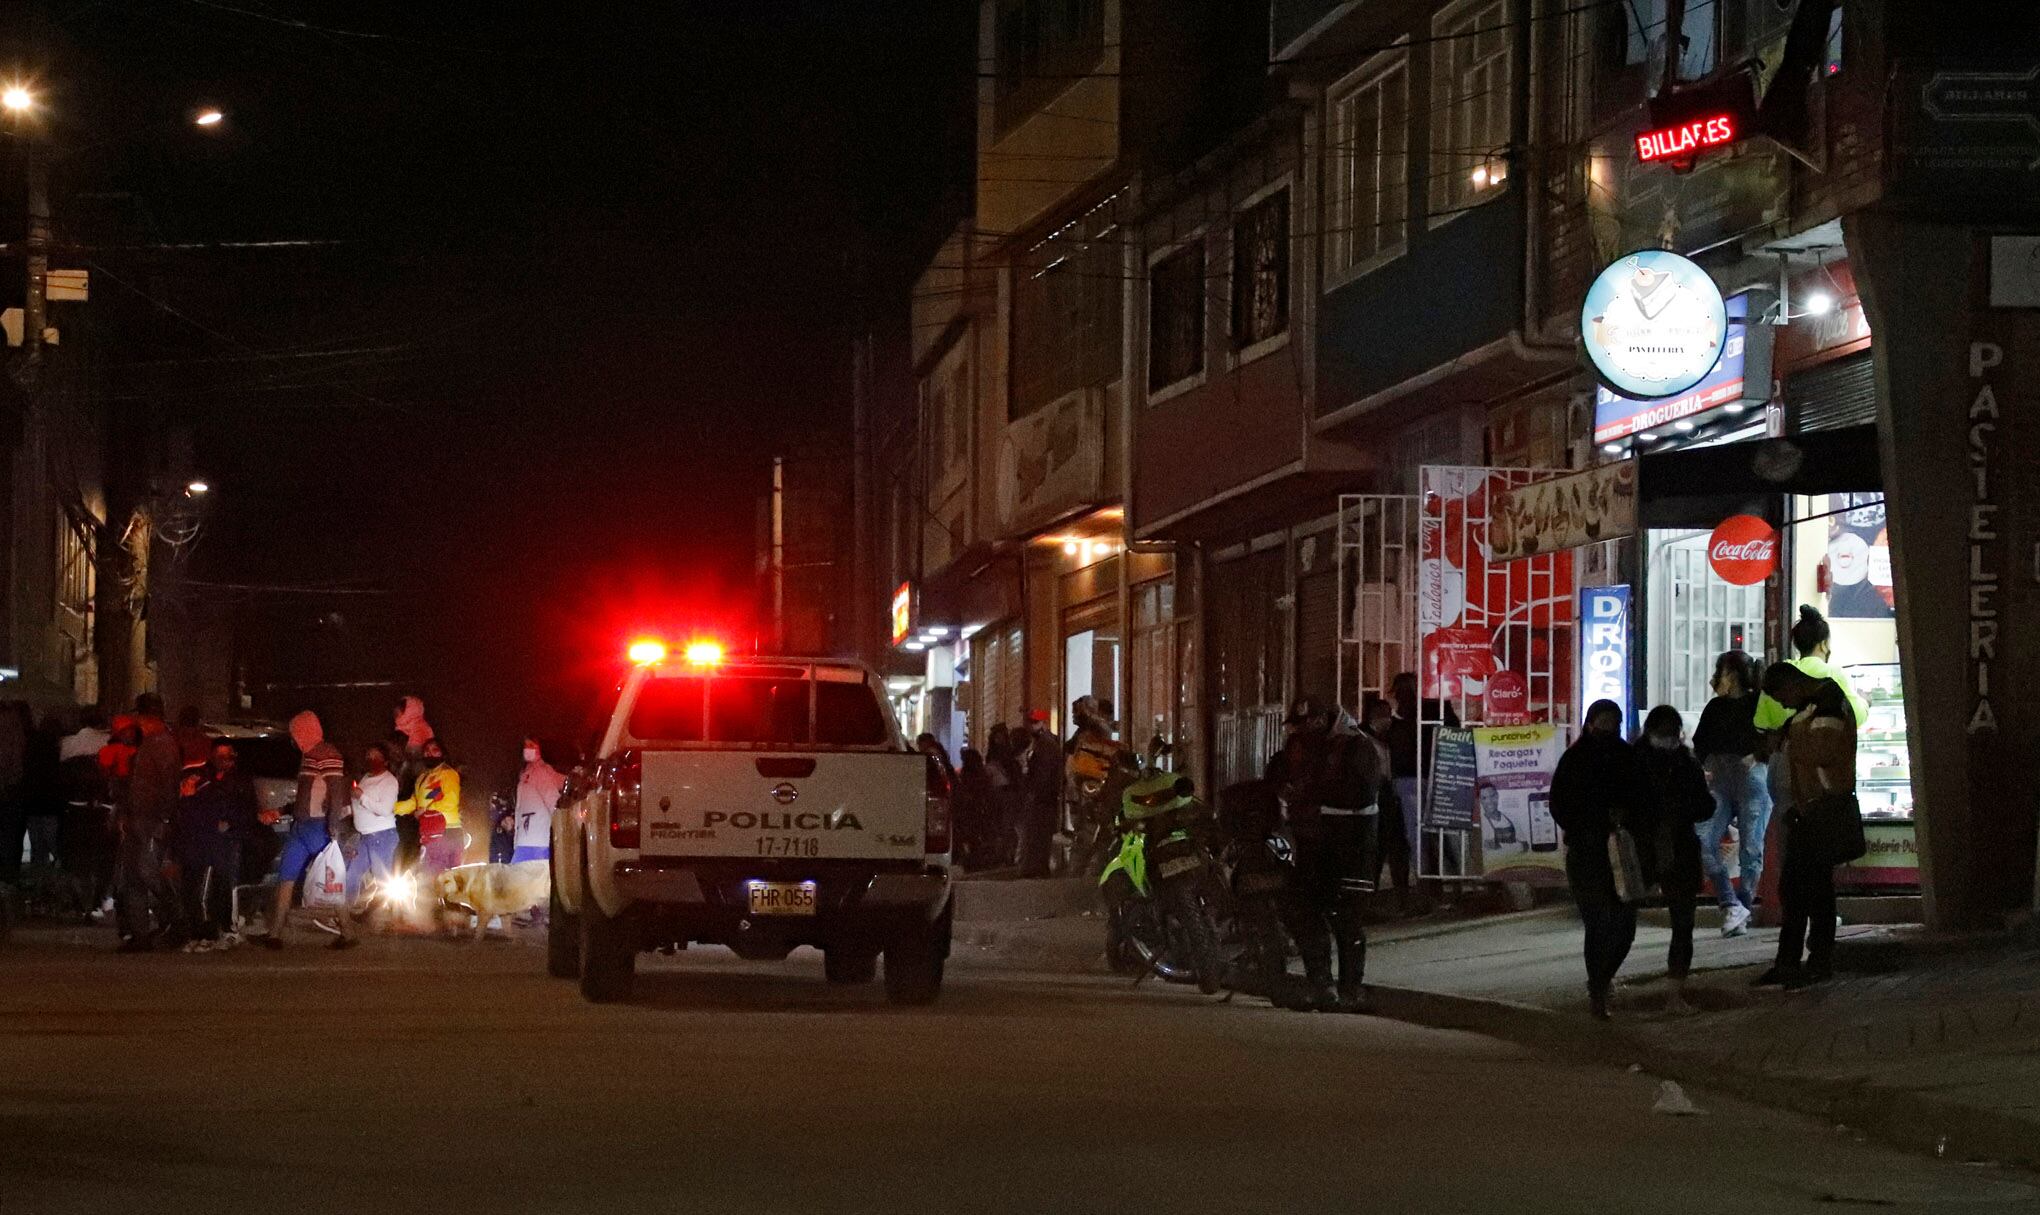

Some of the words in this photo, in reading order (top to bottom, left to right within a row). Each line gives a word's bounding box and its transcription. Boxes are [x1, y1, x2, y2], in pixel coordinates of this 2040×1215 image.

[1638, 117, 1731, 159] BILLARES
[1631, 395, 1703, 433] DROGUERIA
[1969, 341, 2003, 734] PASTELERIA
[1711, 539, 1775, 561] Coca-Cola
[1491, 688, 1518, 698] Claro
[1488, 748, 1534, 758] Recargas
[1536, 748, 1542, 758] y
[1493, 759, 1538, 769] Paquetes
[703, 811, 864, 830] POLICIA
[756, 836, 819, 856] 17-7118
[751, 888, 780, 906] FHR
[784, 888, 813, 906] 055
